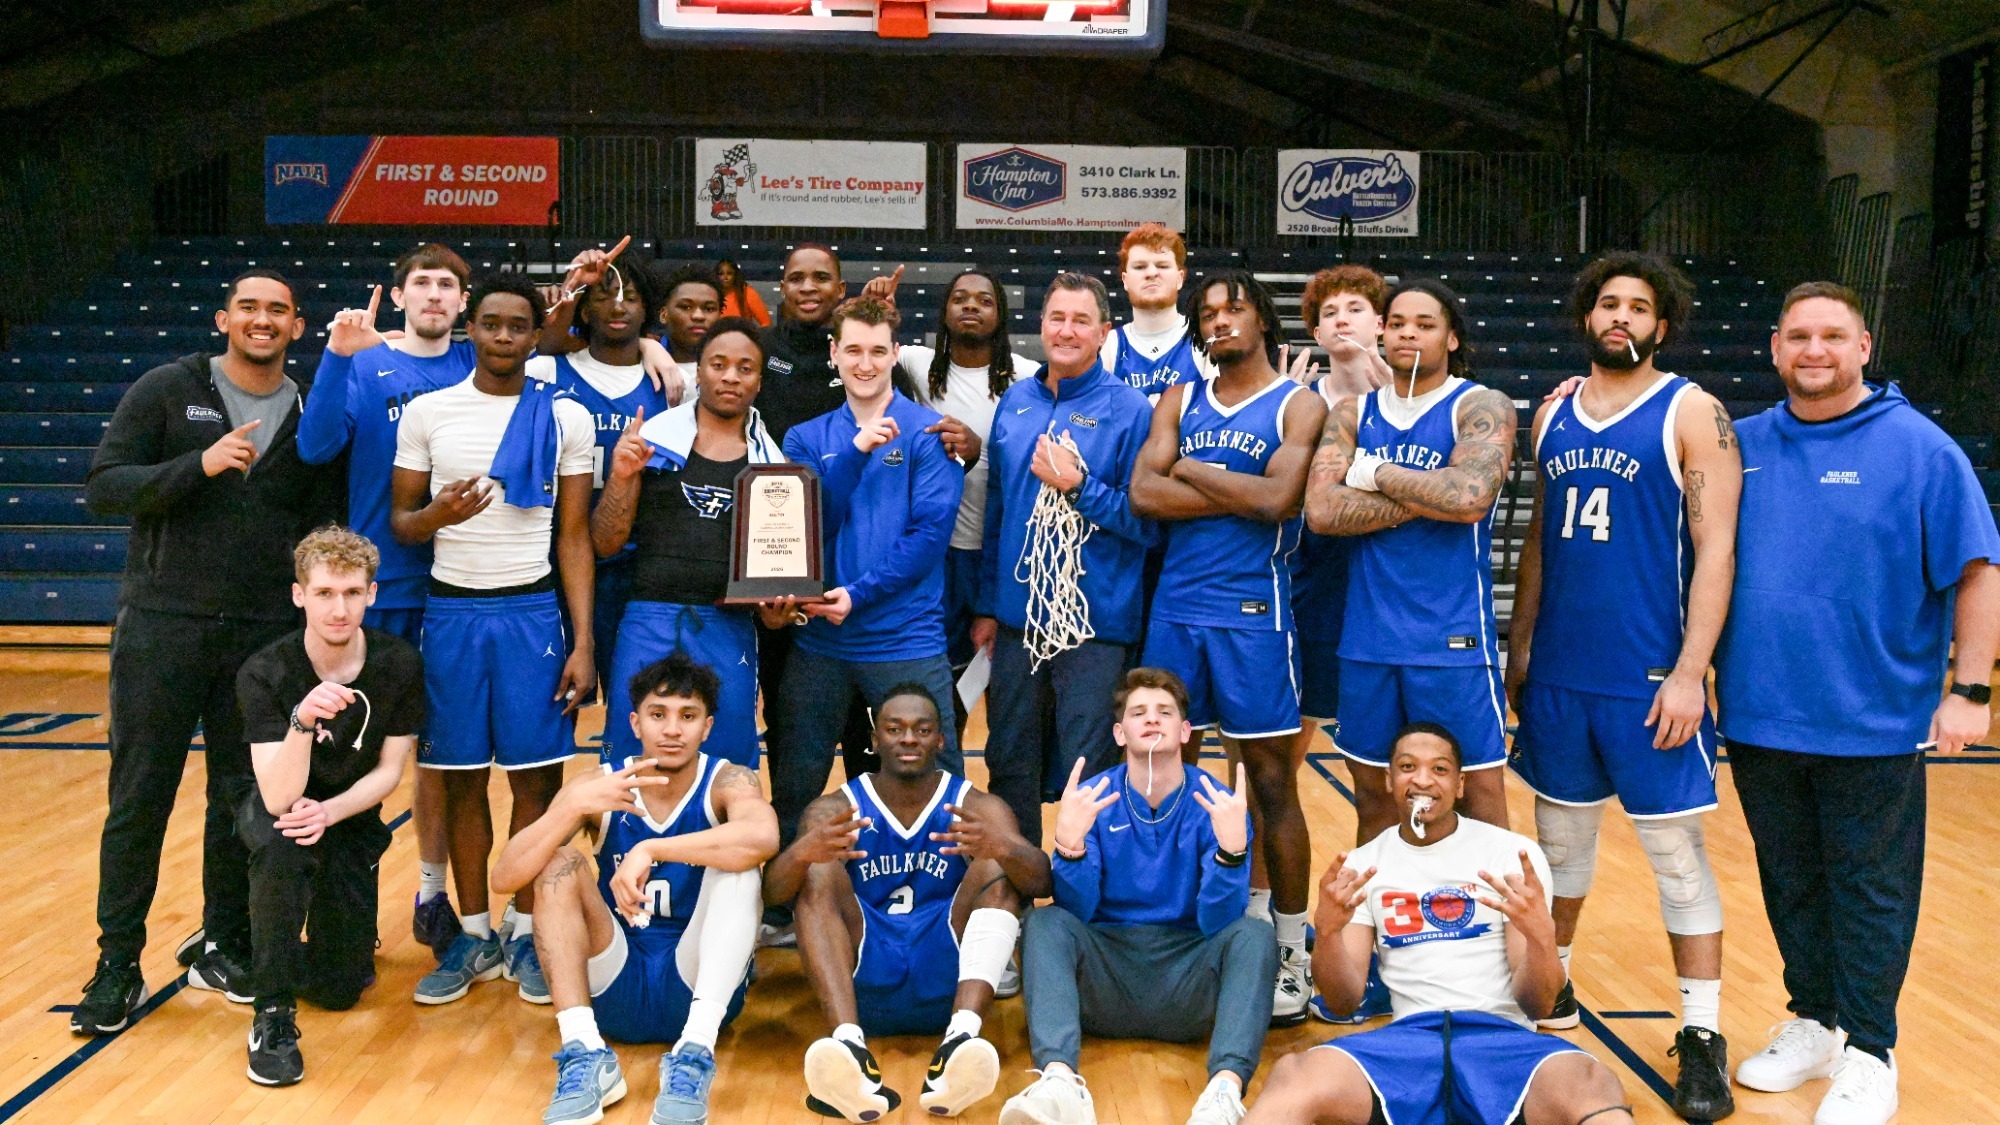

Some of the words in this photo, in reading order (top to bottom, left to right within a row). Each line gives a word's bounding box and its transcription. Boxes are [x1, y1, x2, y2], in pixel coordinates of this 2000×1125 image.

[1097, 27, 1129, 35] DRAPER
[275, 163, 328, 186] NAIA
[375, 164, 435, 181] FIRST
[438, 164, 455, 182] &
[460, 165, 547, 183] SECOND
[972, 164, 1058, 186] Hampton
[1079, 166, 1114, 178] 3410
[1118, 166, 1155, 178] Clark
[1160, 167, 1180, 179] Ln.
[1282, 153, 1404, 211] Culver's
[761, 175, 804, 190] Lee's
[808, 176, 842, 191] Tire
[845, 177, 925, 195] Company
[992, 182, 1034, 202] Inn
[1081, 187, 1177, 199] 573.886.9392
[423, 188, 499, 206] ROUND
[760, 193, 767, 202] If
[767, 193, 781, 203] it's
[782, 194, 804, 203] round
[811, 194, 829, 203] and
[831, 194, 863, 204] rubber,
[864, 195, 886, 204] Lee's
[887, 195, 906, 205] sells
[908, 195, 917, 205] it!
[1287, 225, 1309, 233] 2520
[1358, 224, 1383, 234] Bluffs
[1385, 225, 1409, 234] Drive
[1546, 447, 1641, 482] FAULKNER
[1561, 487, 1610, 541] 14
[859, 851, 949, 882] FAULKNER
[887, 885, 914, 915] 2
[1402, 931, 1460, 944] ANNIVERSARY
